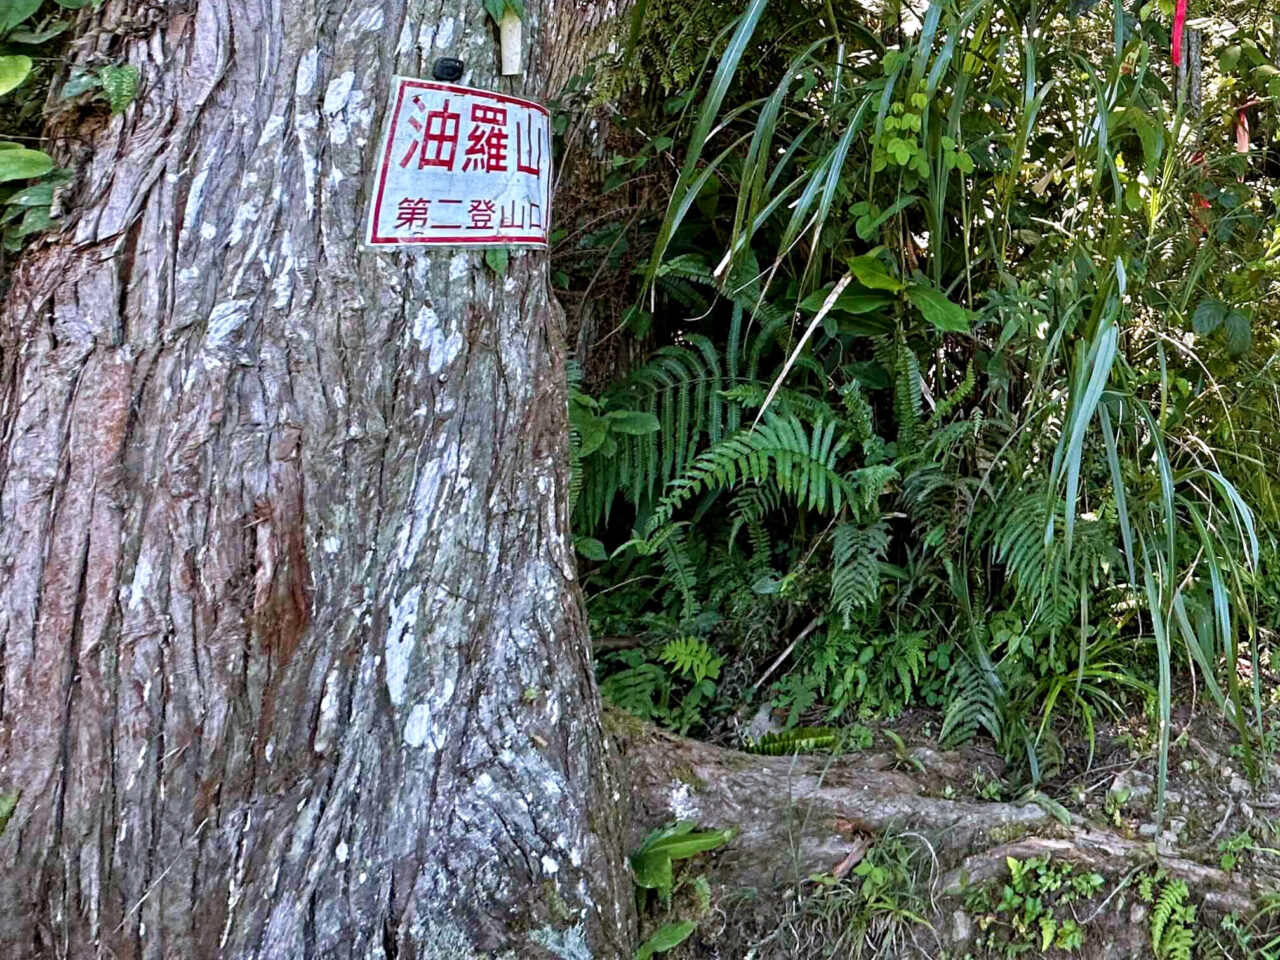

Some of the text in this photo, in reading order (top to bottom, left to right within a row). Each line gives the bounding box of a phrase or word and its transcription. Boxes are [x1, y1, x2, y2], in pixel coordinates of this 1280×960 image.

[399, 98, 541, 180] 油羅山
[394, 197, 542, 230] 第二登山口
